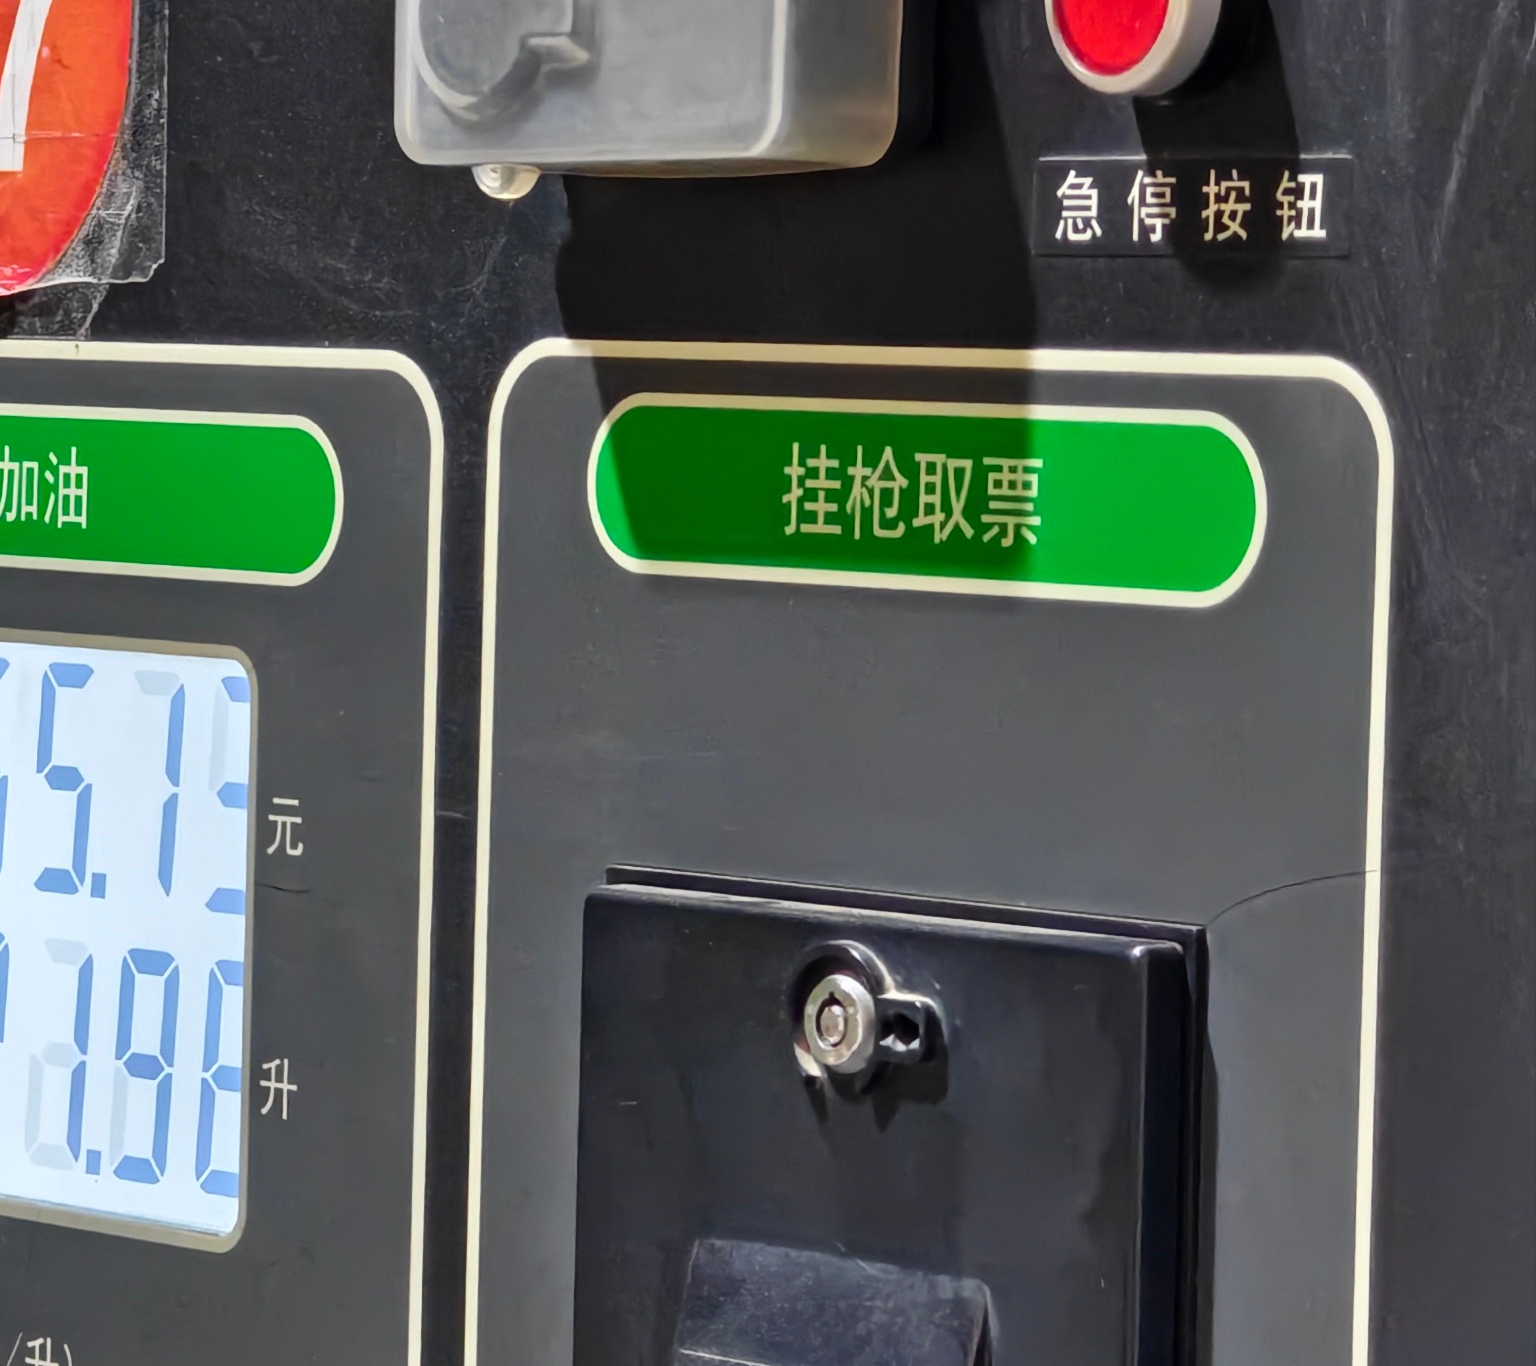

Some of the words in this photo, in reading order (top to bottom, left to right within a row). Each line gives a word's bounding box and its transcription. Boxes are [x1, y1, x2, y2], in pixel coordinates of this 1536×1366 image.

[1055, 168, 1327, 243] 急停按钮
[781, 440, 1045, 548] 挂枪取票
[266, 797, 304, 857] 元
[259, 1058, 298, 1121] 升
